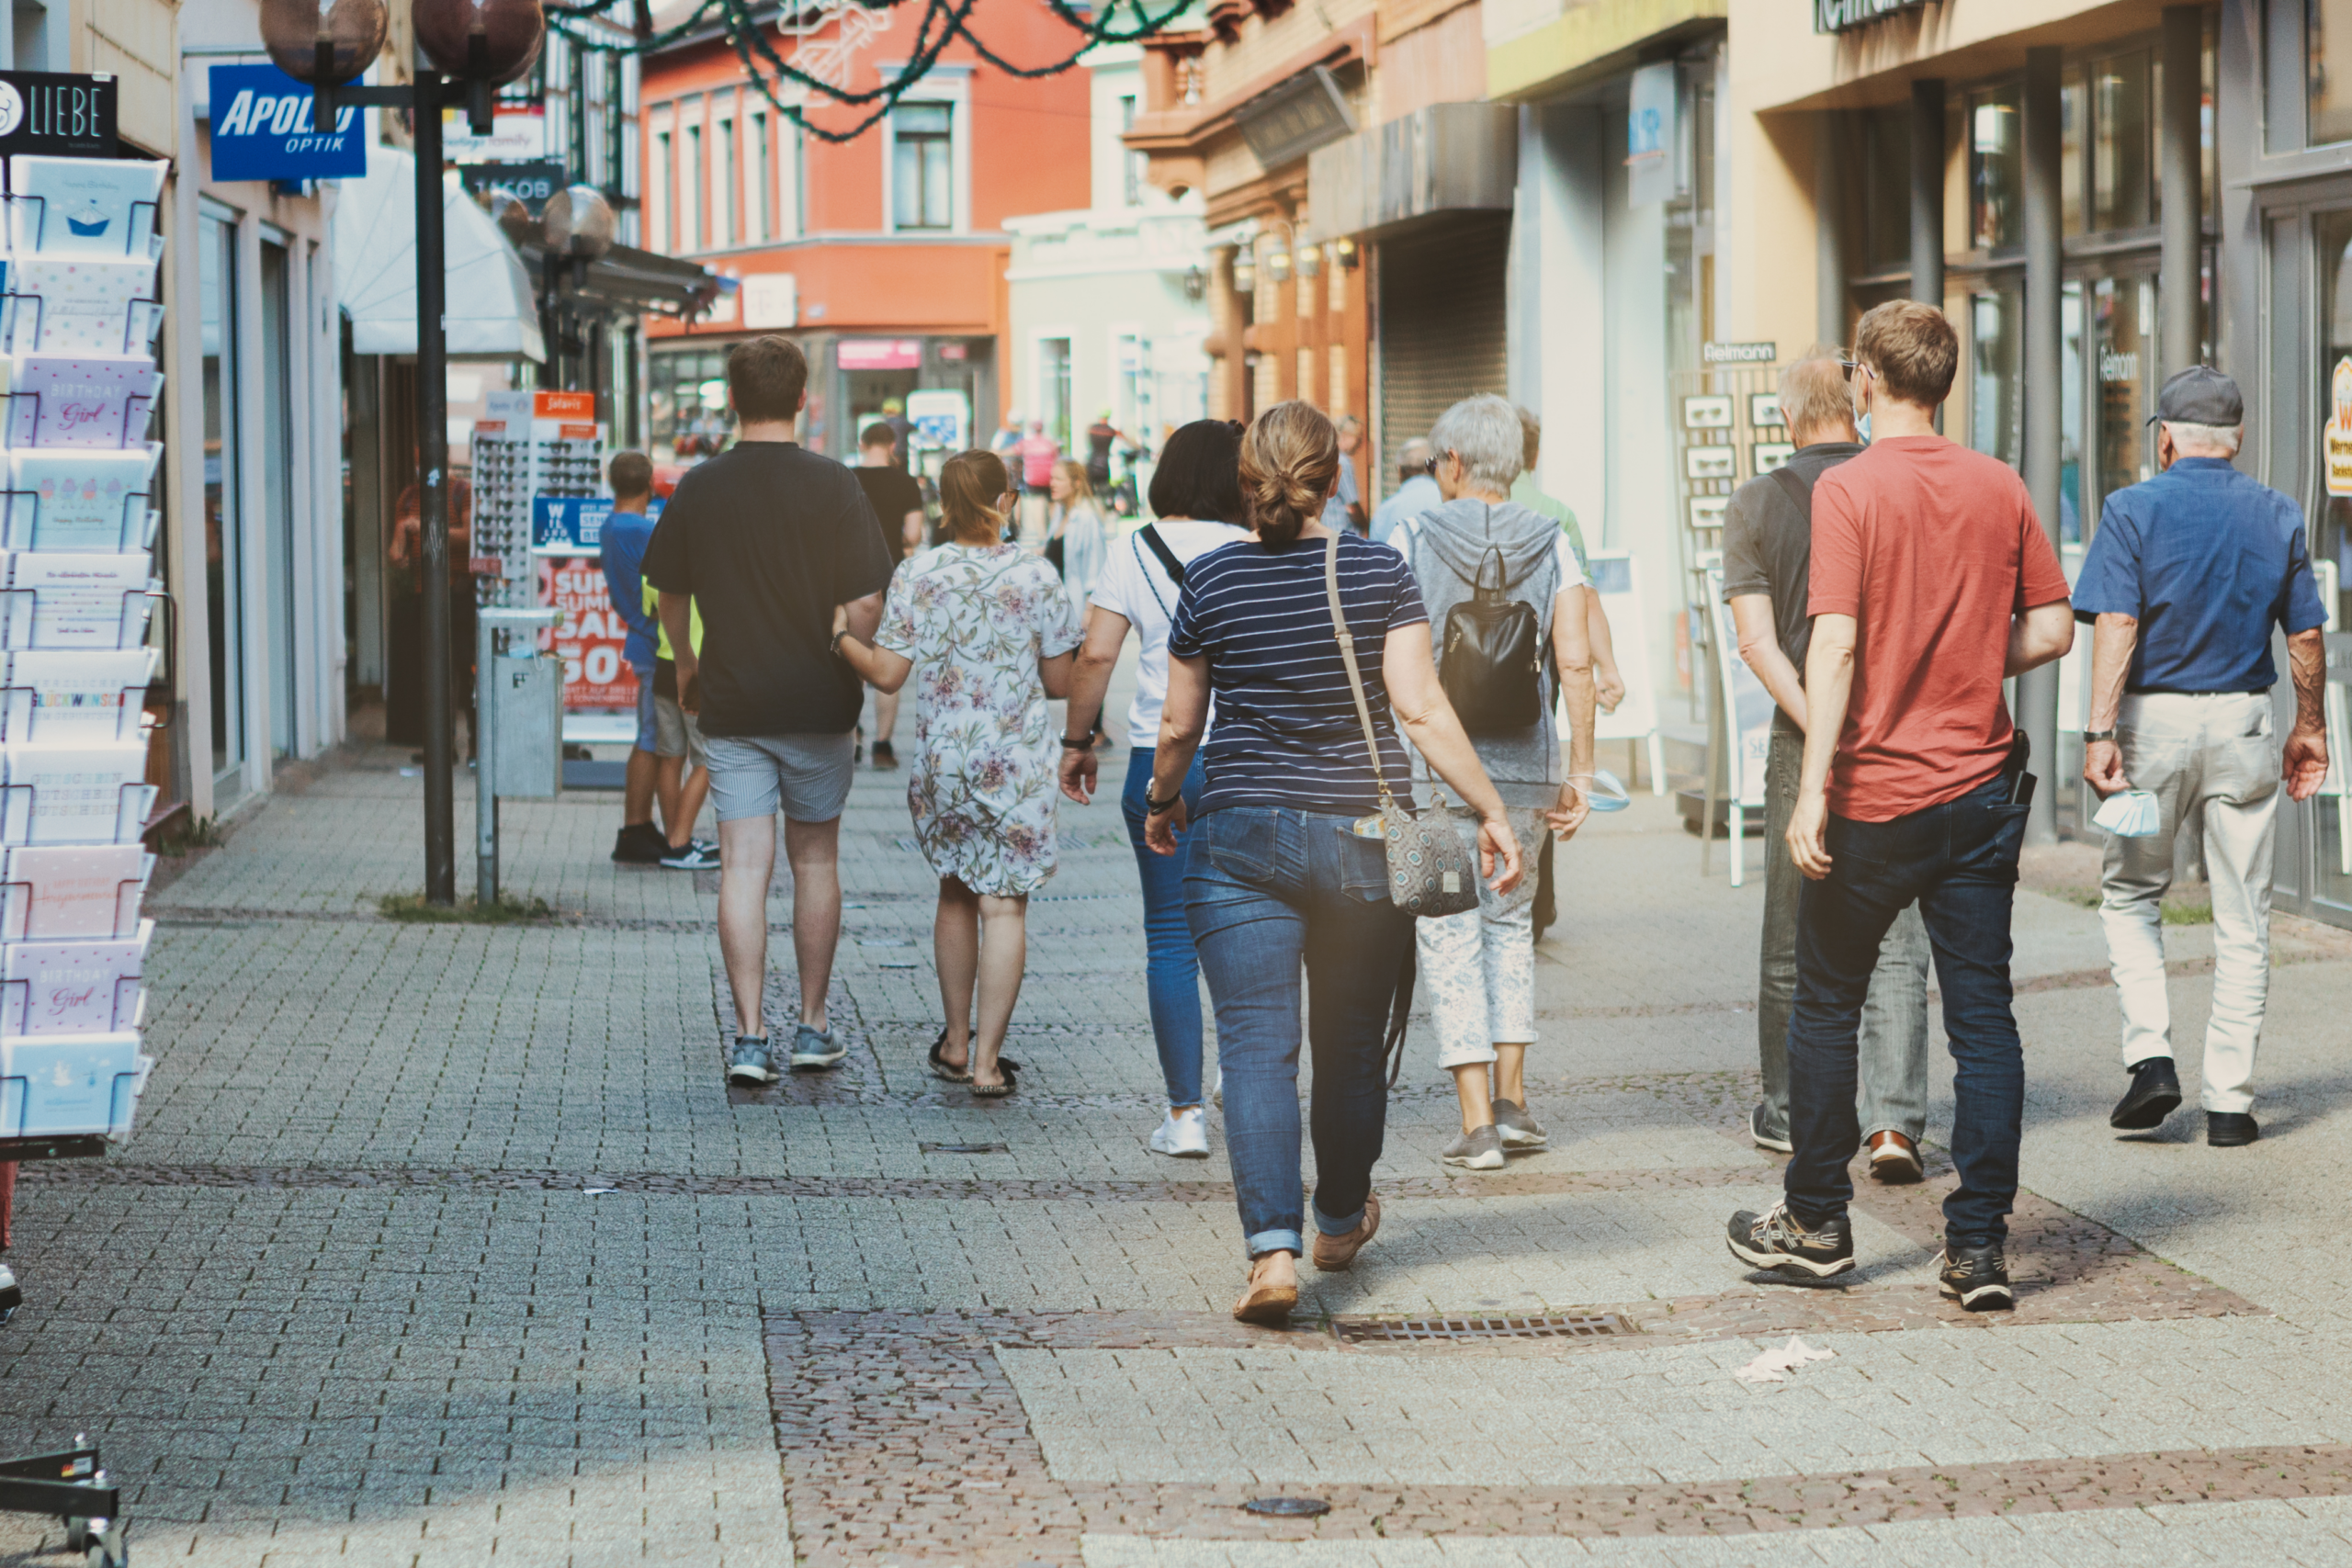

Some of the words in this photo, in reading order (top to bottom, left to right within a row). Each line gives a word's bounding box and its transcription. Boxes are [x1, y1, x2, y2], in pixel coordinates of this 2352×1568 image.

[30, 85, 101, 137] LIEBE
[218, 89, 356, 137] APOLO
[285, 137, 345, 154] OPTIK
[51, 383, 121, 398] BIRTHDAY
[57, 402, 106, 431] Girl
[1748, 737, 1769, 754] SE
[31, 773, 122, 784] GUTSCHEIN
[40, 968, 110, 984] BIRTHDAY
[48, 987, 95, 1016] Girl
